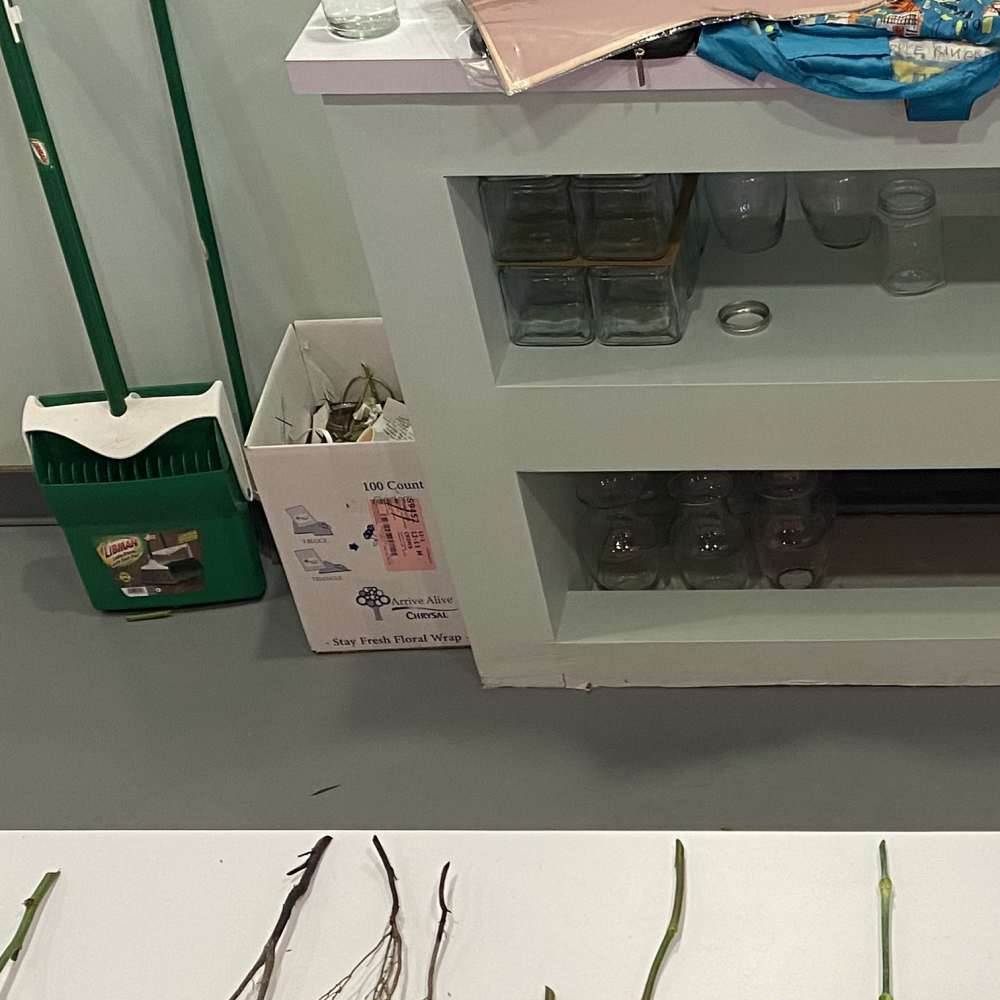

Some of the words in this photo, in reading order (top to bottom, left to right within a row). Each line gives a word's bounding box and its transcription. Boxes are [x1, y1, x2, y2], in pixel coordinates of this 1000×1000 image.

[363, 481, 384, 492] 100
[387, 480, 425, 490] Count
[391, 597, 426, 606] Arrive
[426, 595, 453, 605] Alive
[406, 611, 448, 620] CHRYSAL
[332, 637, 356, 648] Stay
[360, 635, 392, 646] Fresh
[394, 633, 427, 645] Floral
[431, 632, 462, 645] Wrap
